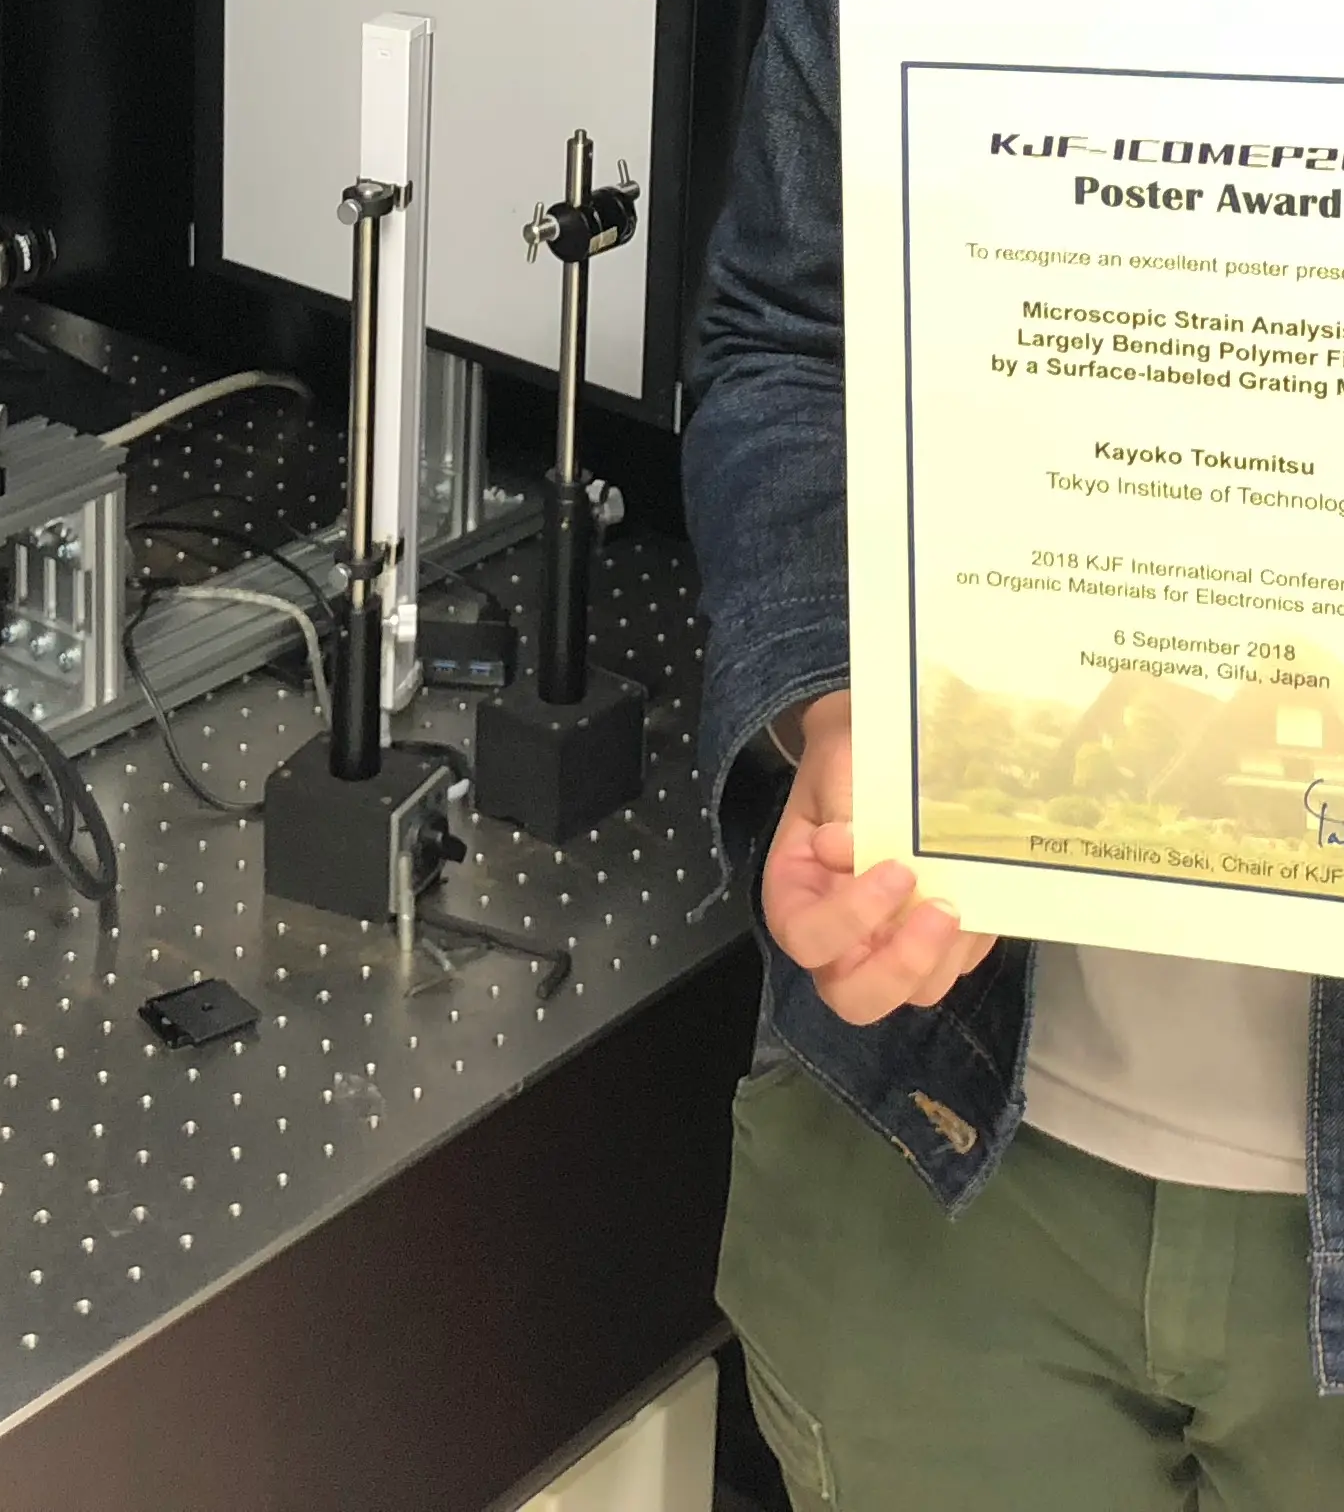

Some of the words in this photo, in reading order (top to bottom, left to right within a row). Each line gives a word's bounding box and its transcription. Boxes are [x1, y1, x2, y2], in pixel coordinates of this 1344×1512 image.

[1075, 176, 1203, 211] Poster
[1217, 184, 1341, 218] Award
[965, 243, 989, 260] To
[996, 249, 1090, 267] recognize
[1098, 255, 1121, 266] an
[1129, 255, 1217, 273] excellent
[1226, 261, 1289, 277] poster
[1023, 301, 1167, 330] Microscopic
[1175, 311, 1244, 333] Strain
[1018, 328, 1103, 355] Largely
[1113, 335, 1210, 362] Bending
[1220, 342, 1318, 366] Polymer
[992, 354, 1017, 377] by
[1026, 361, 1037, 374] a
[1047, 358, 1230, 387] Surface-labeled
[1239, 372, 1327, 399] Grating
[1096, 442, 1182, 465] Kayoko
[1191, 449, 1314, 475] Tokumitsu
[1046, 472, 1109, 496] Tokyo
[1119, 477, 1202, 501] Institute
[1211, 486, 1231, 502] of
[1032, 551, 1078, 568] 2018
[1087, 555, 1123, 572] KJF
[1132, 559, 1252, 583] International
[957, 573, 979, 584] on
[987, 571, 1061, 592] Organic
[1069, 577, 1156, 599] Materials
[1164, 585, 1188, 602] for
[1197, 588, 1304, 612] Electronics
[1114, 630, 1125, 645] 6
[1133, 631, 1240, 655] September
[1247, 642, 1295, 661] 2018
[1081, 651, 1208, 679] Nagaragawa,
[1217, 663, 1262, 684] Gifu,
[1270, 668, 1329, 689] Japan
[1030, 835, 1071, 854] Prof.
[1082, 840, 1161, 864] Takahiro
[1169, 850, 1214, 872] Seki,
[1222, 853, 1274, 877] Chair
[1280, 864, 1299, 880] of
